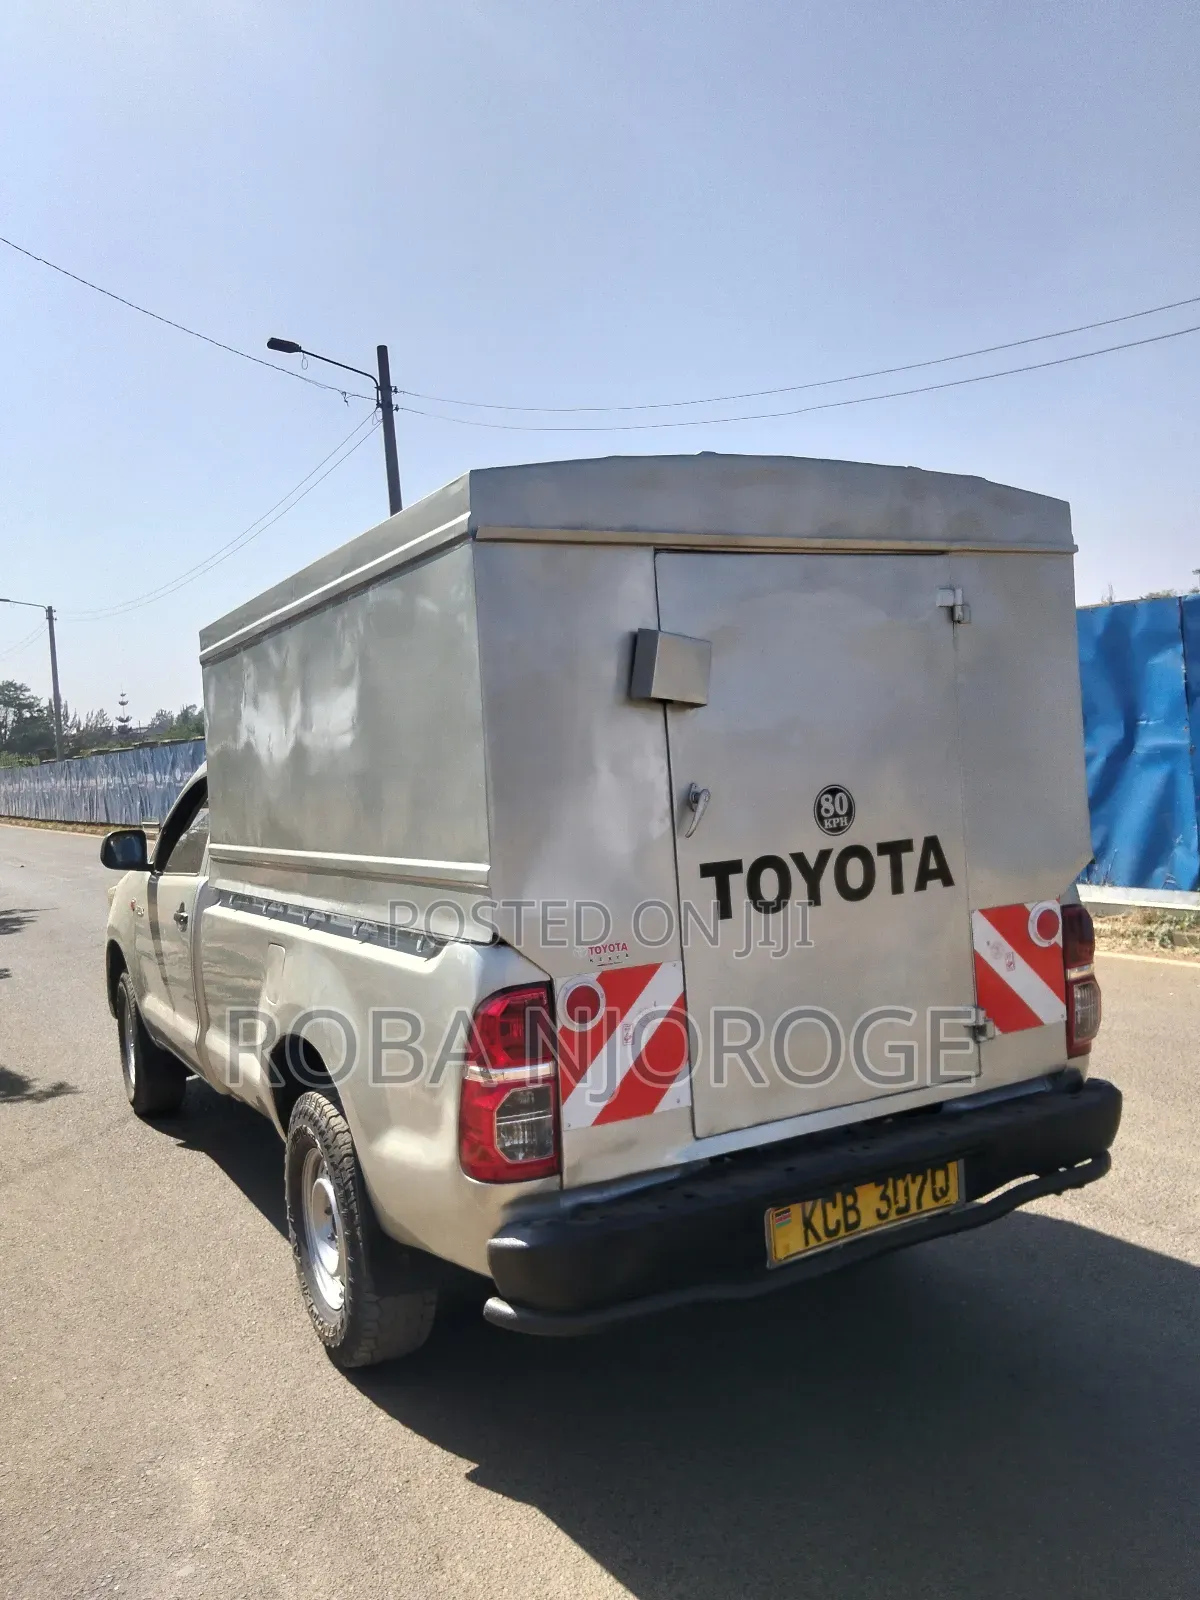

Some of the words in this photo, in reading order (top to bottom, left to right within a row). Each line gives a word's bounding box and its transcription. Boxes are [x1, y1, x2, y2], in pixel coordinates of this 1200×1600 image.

[820, 791, 848, 818] 80
[823, 815, 848, 829] KPH
[699, 834, 955, 920] TOYOTA
[588, 942, 628, 955] TOYOTA
[802, 1192, 861, 1247] KCB
